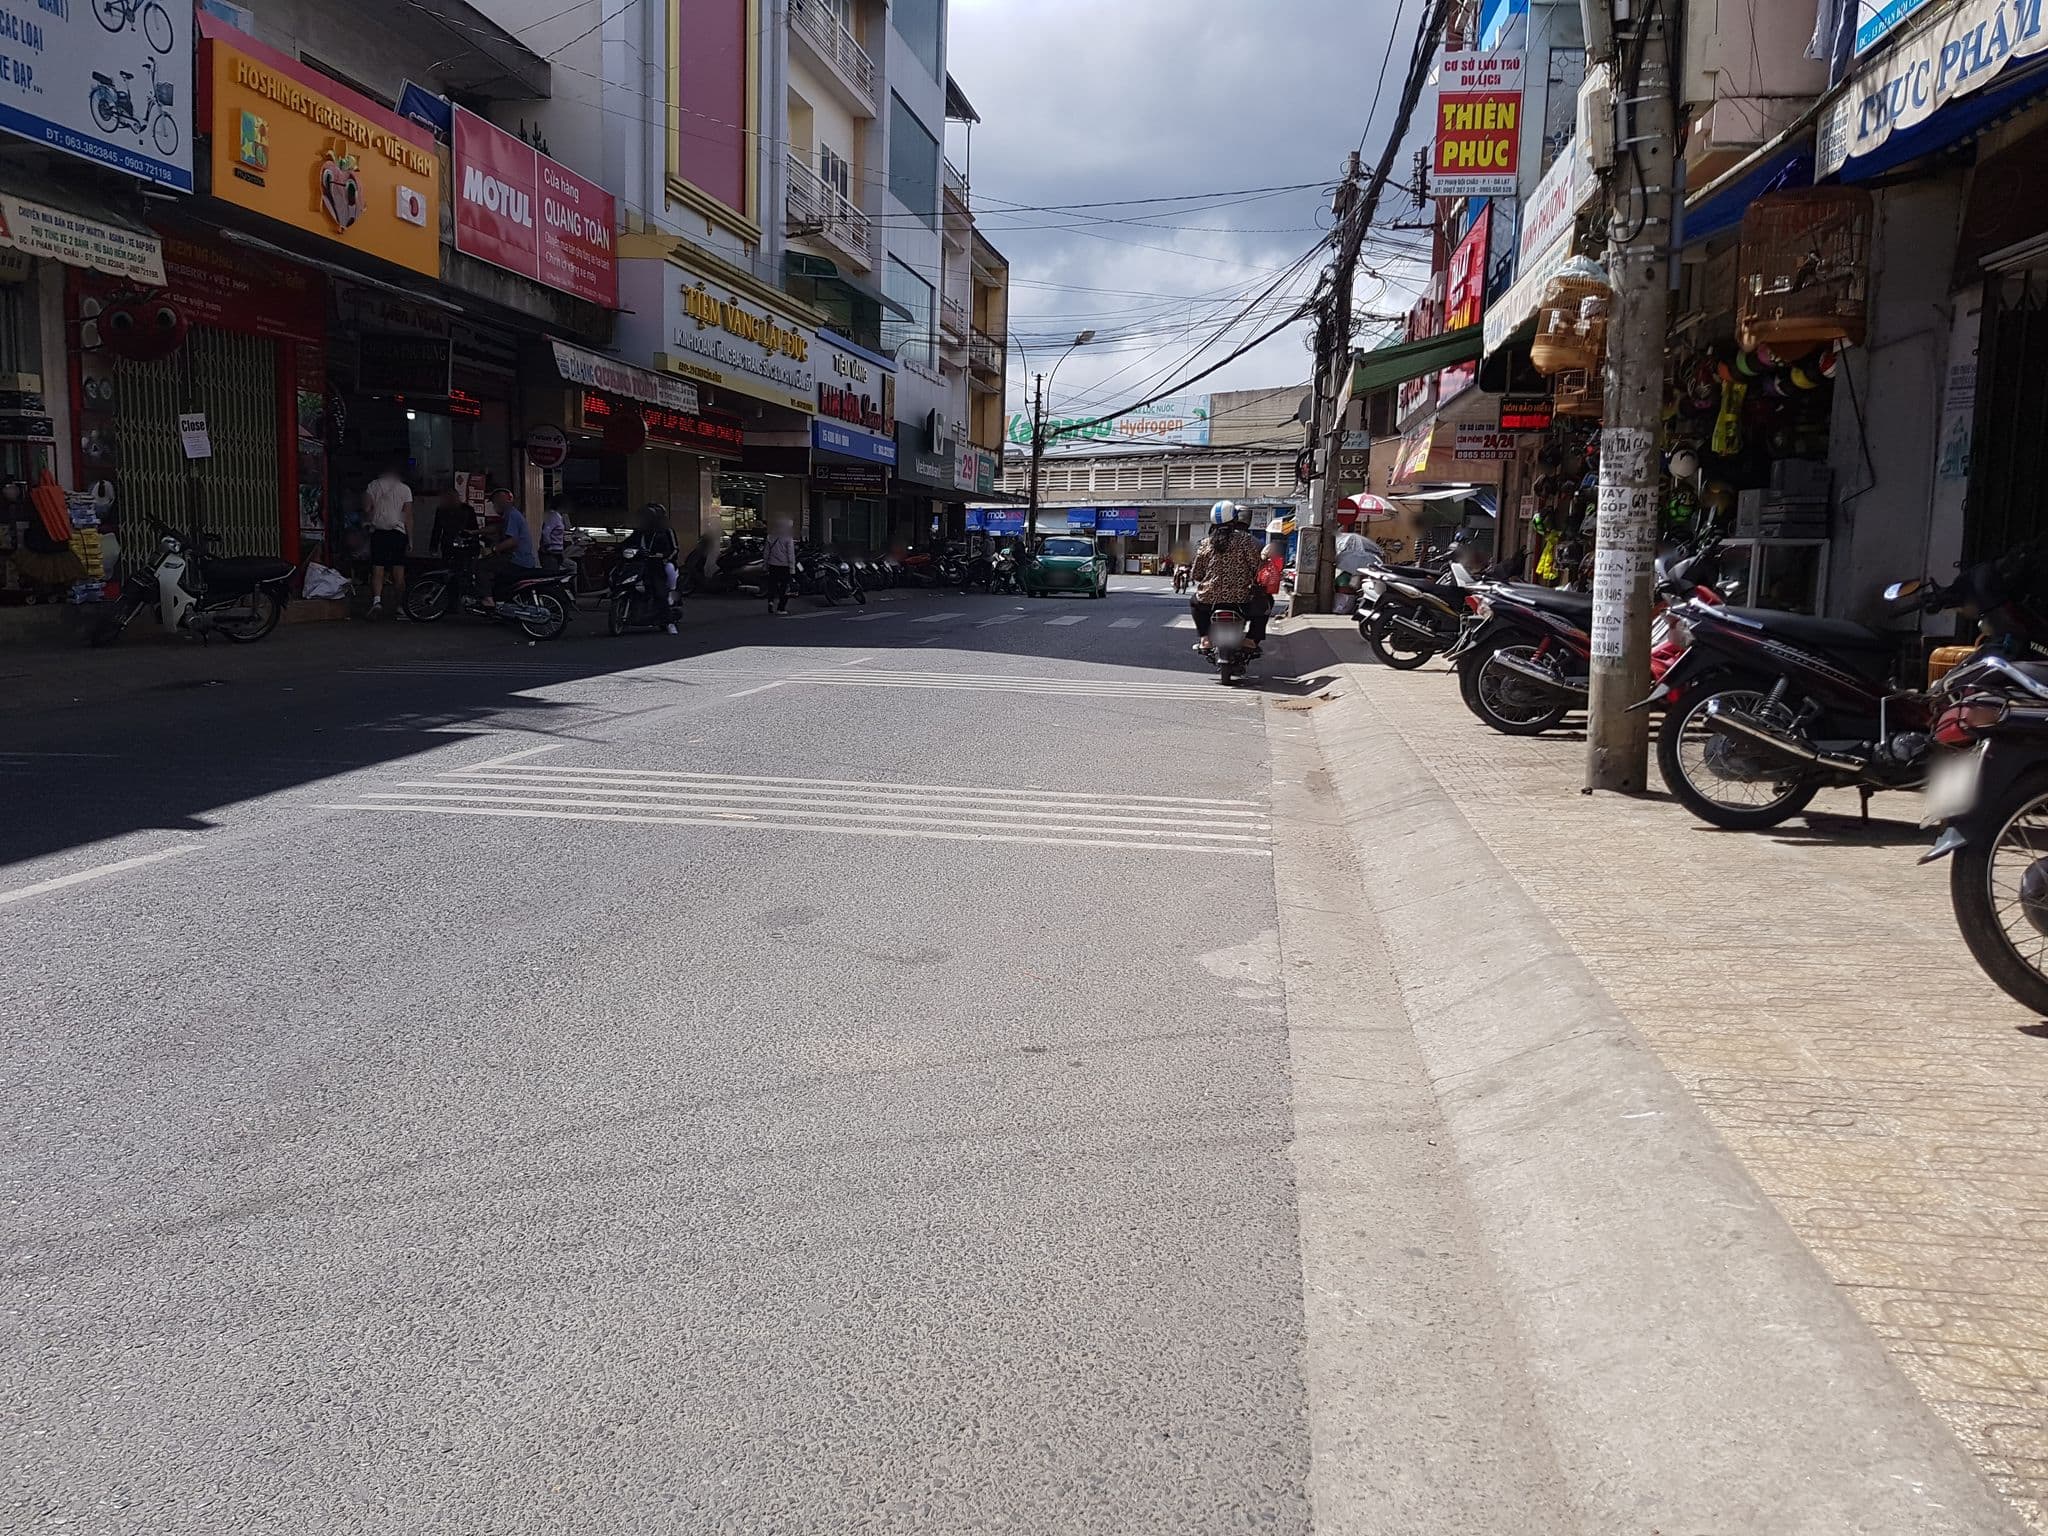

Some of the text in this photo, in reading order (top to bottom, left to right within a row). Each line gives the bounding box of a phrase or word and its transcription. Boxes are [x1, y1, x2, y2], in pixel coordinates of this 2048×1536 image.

[21, 19, 43, 56] LOẠI
[1444, 57, 1520, 72] CƠ SỞ LƯU TRÚ
[1461, 74, 1501, 87] DU LỊCH
[237, 60, 375, 149] HOSHINASTARBERRY
[410, 155, 433, 177] NAM
[1443, 97, 1515, 130] THIÊN
[1442, 134, 1509, 167] PHÚC
[462, 164, 533, 229] MOTUL
[544, 167, 580, 204] Cửa hàng
[544, 197, 610, 251] QUANG TOÀN
[181, 419, 207, 433] Close
[1120, 418, 1183, 438] Hydrogen
[1483, 434, 1515, 449] 24/24
[962, 454, 973, 480] 29
[1600, 500, 1628, 512] GÓP
[1601, 488, 1626, 499] VAY
